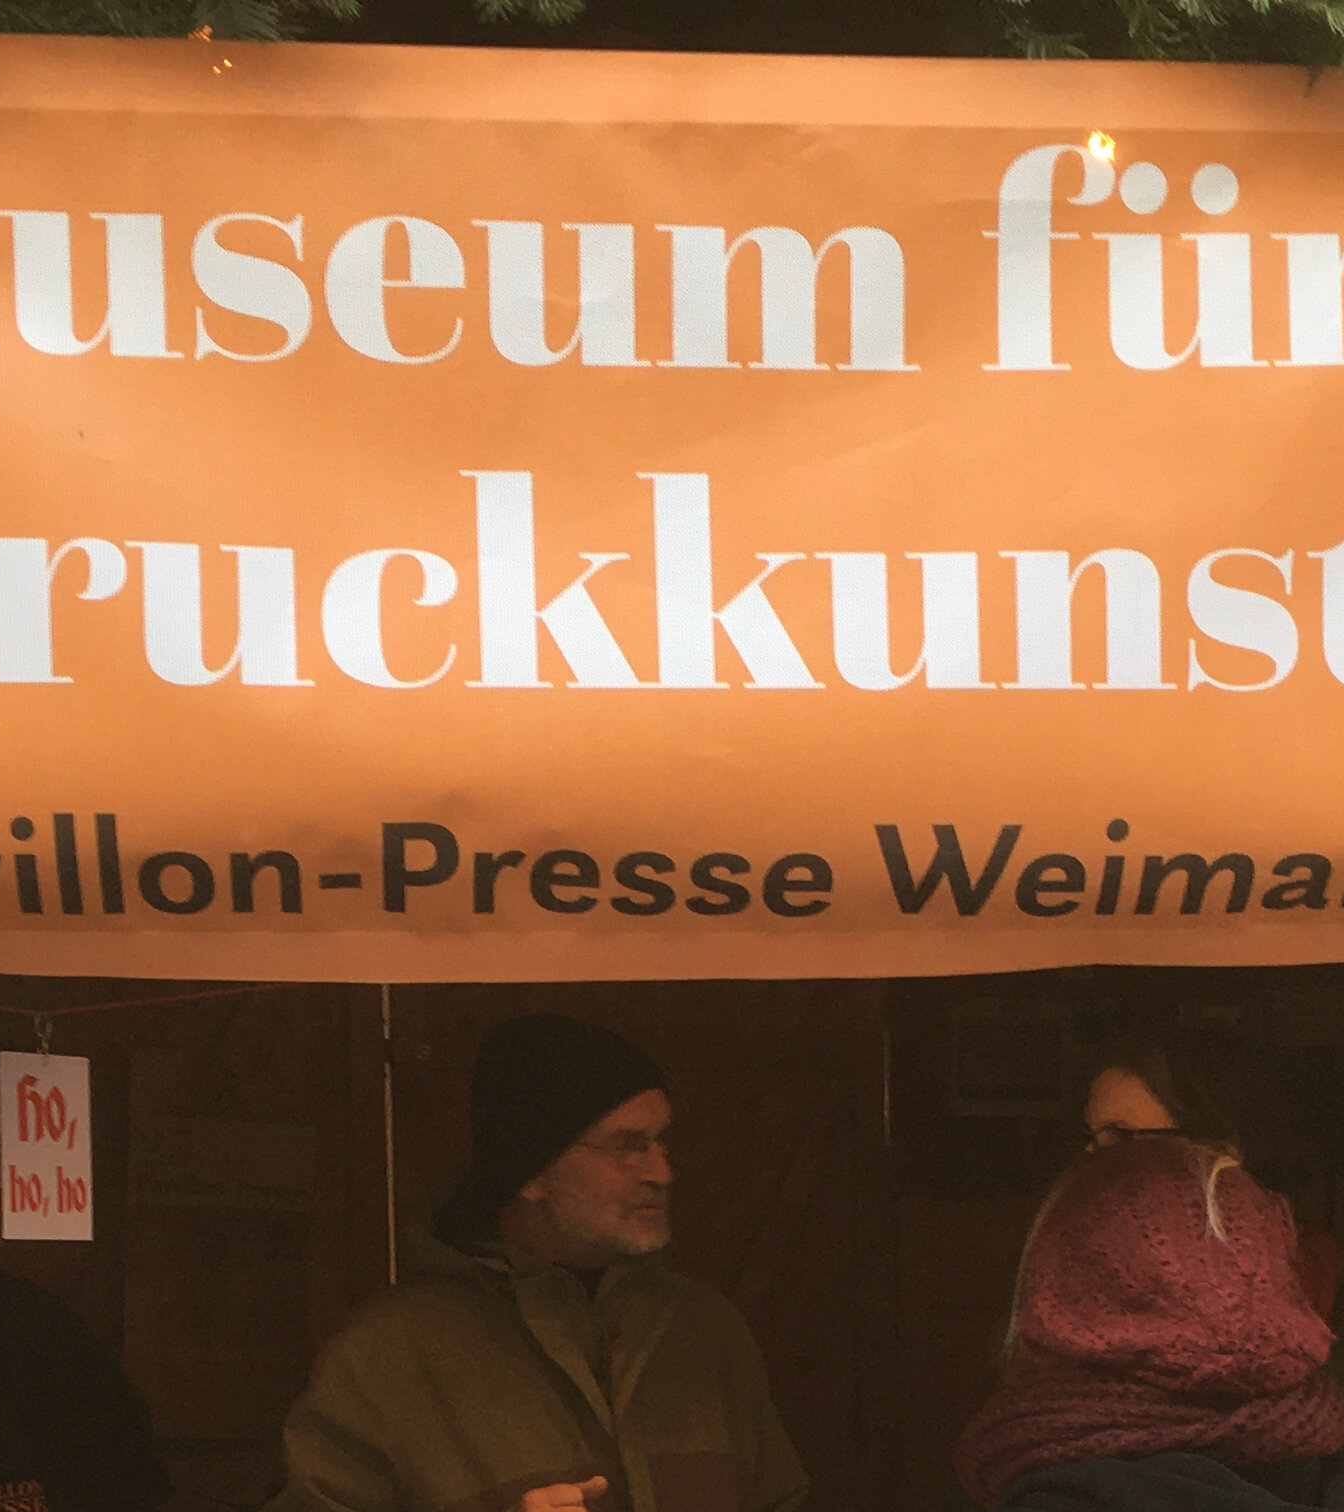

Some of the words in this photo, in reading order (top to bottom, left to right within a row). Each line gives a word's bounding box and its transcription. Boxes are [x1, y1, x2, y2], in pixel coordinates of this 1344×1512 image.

[17, 1074, 78, 1149] ho,
[8, 1164, 50, 1218] ho,
[57, 1166, 88, 1214] ho
